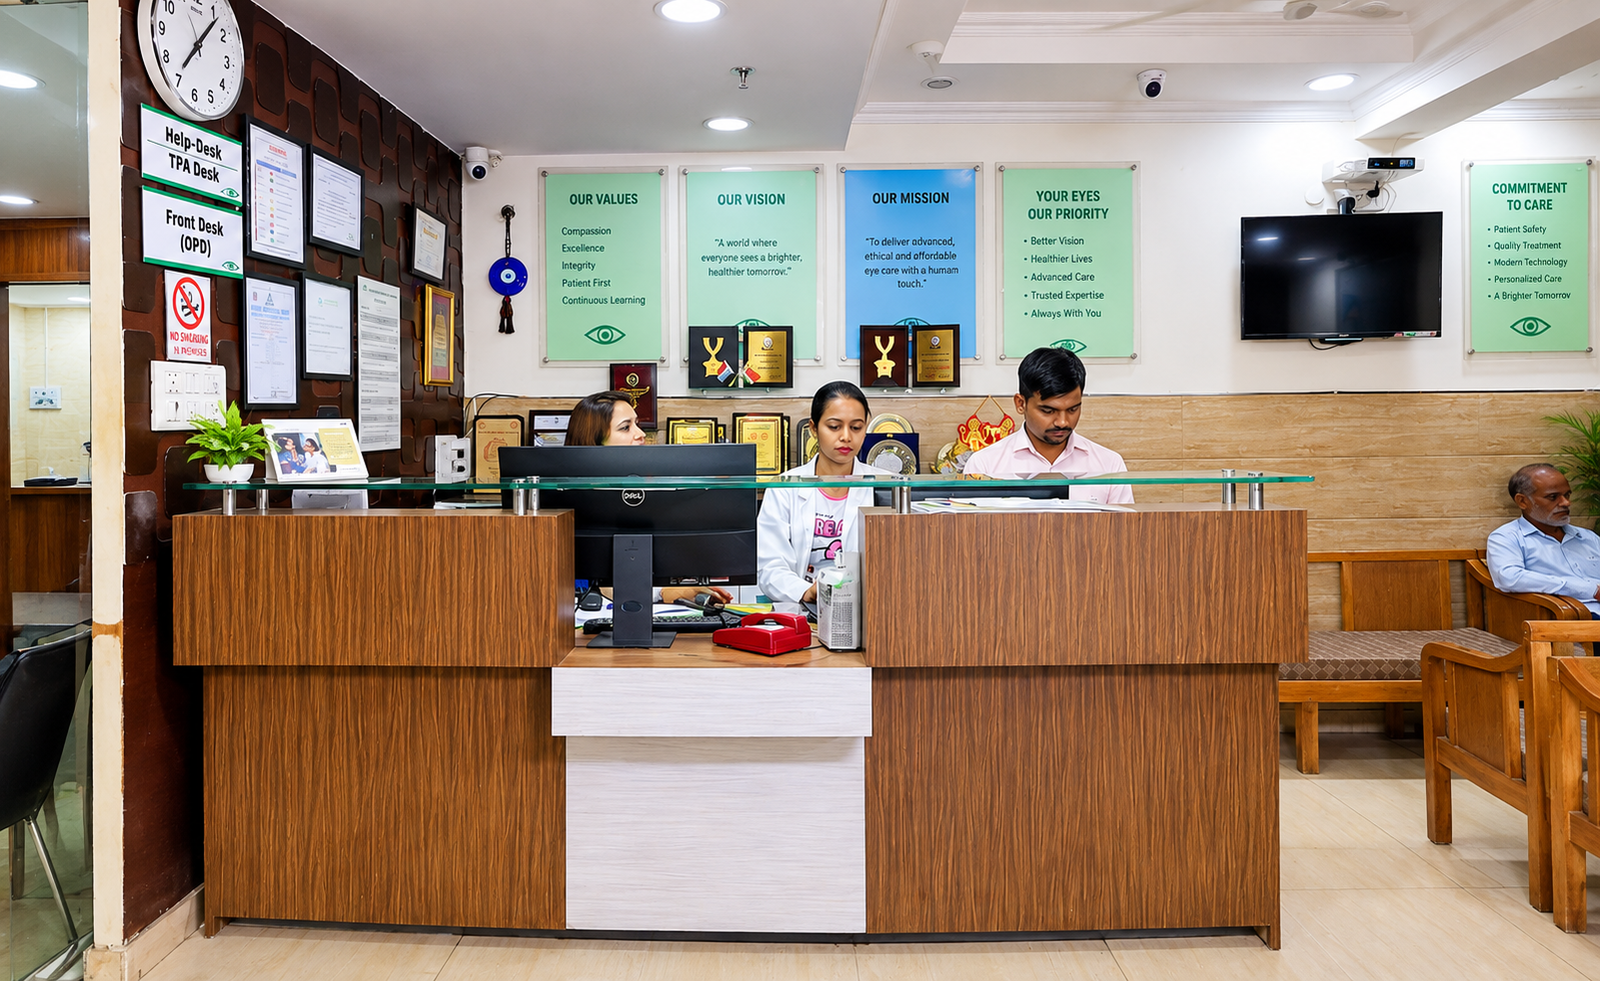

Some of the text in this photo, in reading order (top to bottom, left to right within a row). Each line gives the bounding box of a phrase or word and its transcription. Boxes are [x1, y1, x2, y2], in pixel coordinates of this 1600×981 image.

[159, 21, 165, 35] 9
[220, 28, 226, 43] 2
[163, 49, 169, 63] 8
[224, 55, 230, 69] 3
[175, 73, 182, 87] 7
[219, 78, 225, 91] 4
[191, 88, 198, 102] 6
[207, 89, 214, 103] 5
[165, 126, 222, 161] Help-Desk
[169, 153, 220, 183] TPA Desk
[1492, 182, 1568, 194] COMMITMENT
[569, 193, 638, 205] OUR VALUES
[718, 193, 785, 205] OUR VISION
[872, 192, 949, 204] OUR MISSION
[1036, 190, 1100, 202] YOUR EYES
[1507, 199, 1553, 210] TO CARE
[1028, 208, 1109, 220] OUR PRIORITY
[166, 209, 224, 237] Front Desk
[561, 226, 611, 237] Compassion
[1494, 224, 1547, 235] Patient Safety
[180, 234, 211, 258] (OPD)
[726, 238, 750, 247] world
[881, 237, 910, 246] deliver
[1031, 236, 1084, 245] Better Vision
[1523, 241, 1561, 250] Treatment
[562, 243, 605, 253] Excellence
[701, 255, 739, 264] everyone
[767, 253, 802, 264] brighter,
[864, 251, 957, 260] ethical and affordable
[1031, 254, 1093, 263] Healthier Lives
[562, 261, 596, 272] Integrity
[1494, 258, 1568, 268] Modern Technology
[708, 267, 745, 277] healthier
[864, 268, 880, 277] eye
[901, 266, 919, 275] with
[920, 267, 927, 275] a
[1031, 272, 1095, 281] Advanced Care
[562, 278, 611, 287] Patient First
[1494, 274, 1562, 283] Personalized Care
[562, 296, 646, 306] Continuous Learning
[1031, 290, 1104, 301] Trusted Expertise
[1494, 292, 1500, 300] A
[1502, 291, 1532, 302] Brighter
[1031, 309, 1101, 320] Always With You
